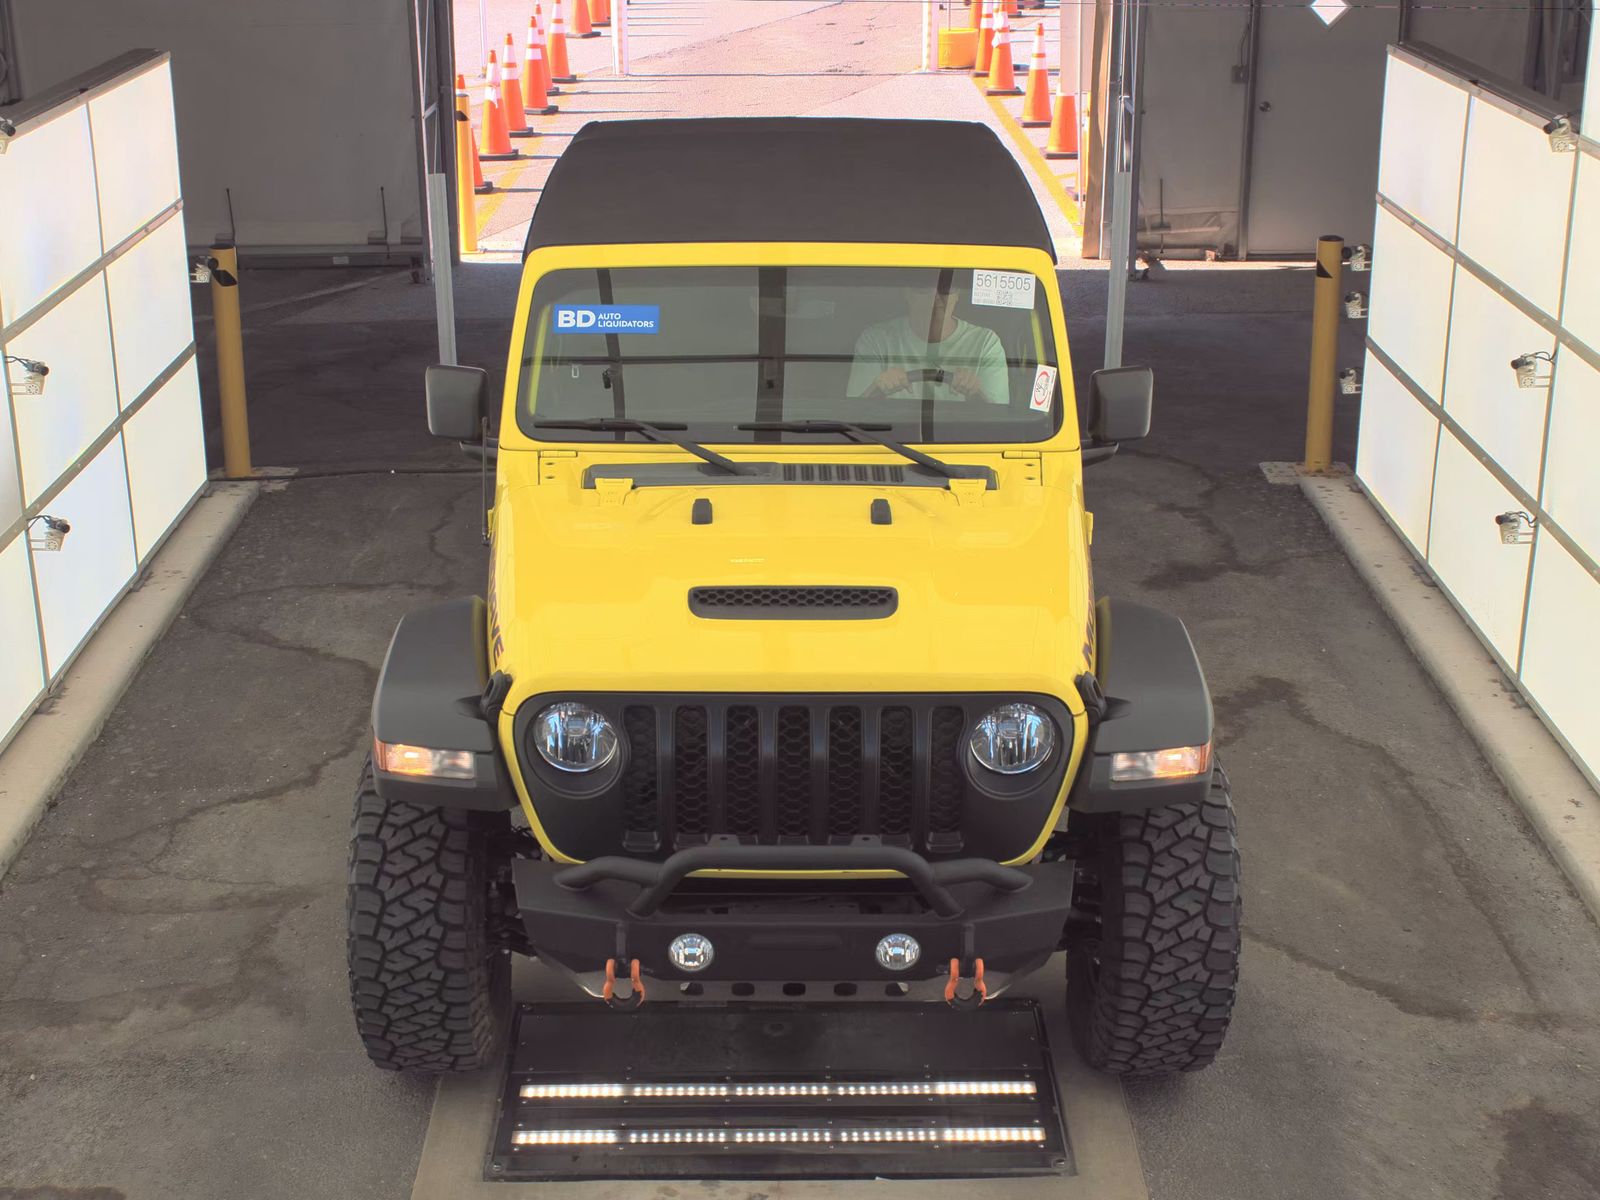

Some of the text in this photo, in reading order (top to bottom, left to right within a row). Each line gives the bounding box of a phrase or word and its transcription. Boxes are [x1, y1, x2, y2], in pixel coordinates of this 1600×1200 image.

[976, 274, 1031, 291] 5615505
[557, 310, 596, 328] BD
[598, 320, 654, 328] LIQUIDATORS
